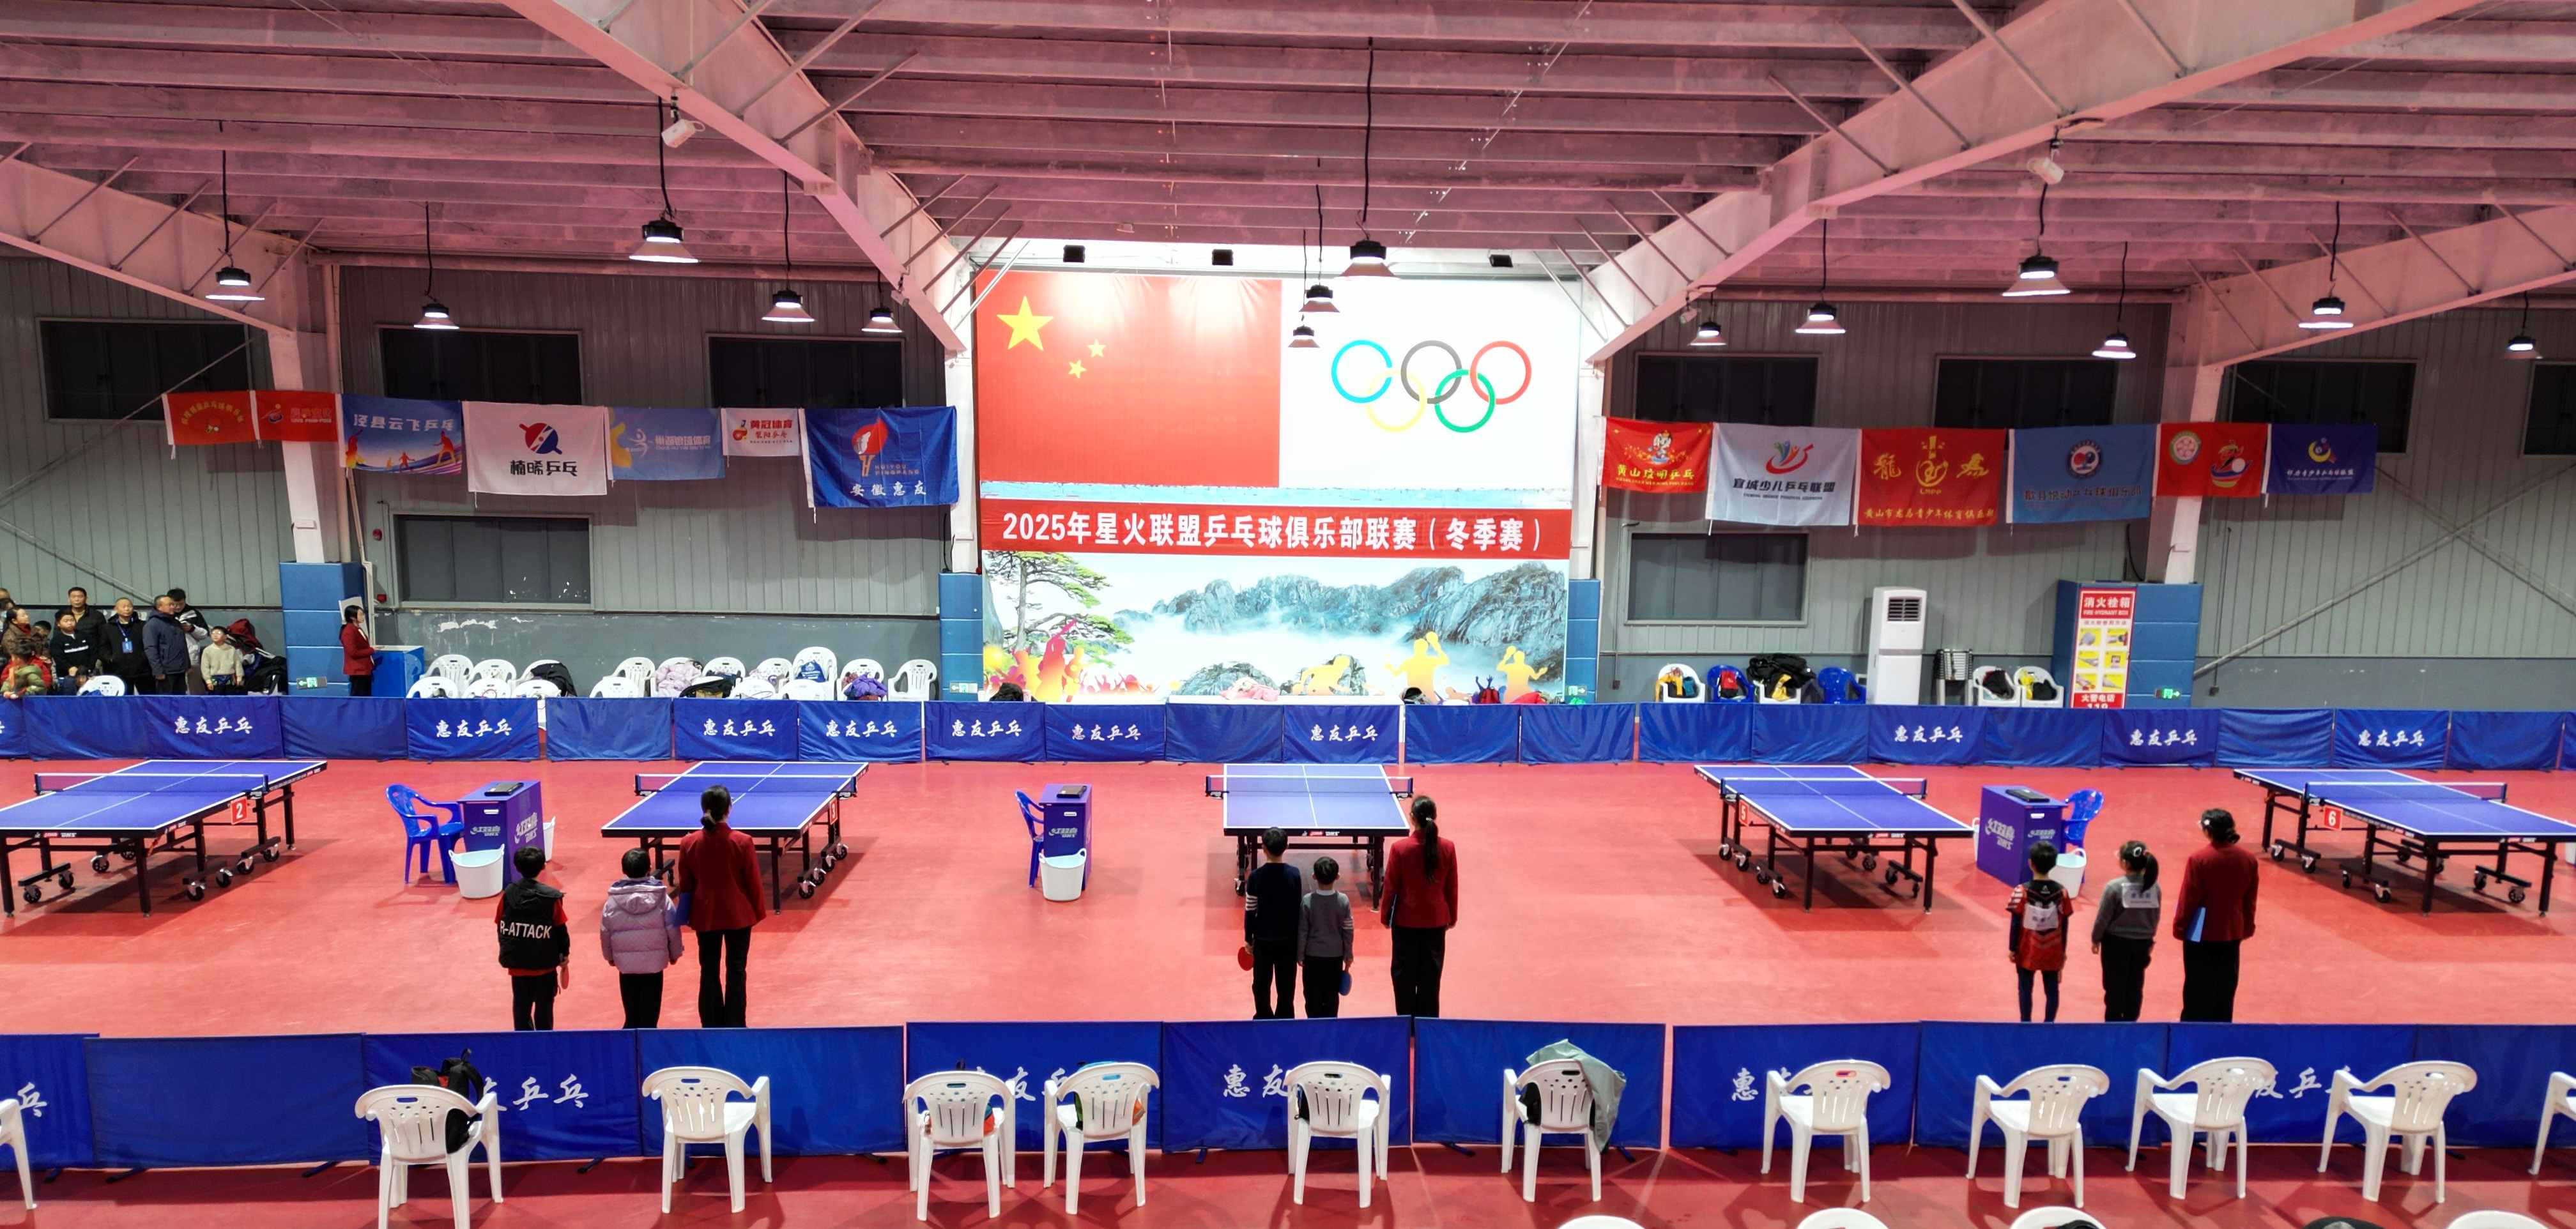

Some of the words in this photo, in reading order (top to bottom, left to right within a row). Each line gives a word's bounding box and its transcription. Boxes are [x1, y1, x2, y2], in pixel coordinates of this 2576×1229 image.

[850, 480, 926, 497] 安徽惠友
[1733, 478, 1836, 492] 宣城少儿乒乓联盟
[2084, 597, 2131, 608] 消火栓箱
[2081, 694, 2115, 703] 火警电话
[174, 716, 252, 734] 惠友乒乓
[436, 719, 511, 737] 惠友乒乓
[704, 719, 775, 736] 惠友乒乓
[826, 720, 897, 737] 惠友乒乓
[952, 719, 1022, 737] 惠友乒乓
[1072, 724, 1140, 741] 惠友乒乓
[1310, 724, 1377, 741] 惠友乒乓
[1895, 726, 1963, 742] 惠友乒乓
[2130, 729, 2197, 746] 惠友乒乓
[2359, 730, 2424, 746] 惠友乒乓
[236, 803, 243, 819] 2
[1741, 805, 1746, 820] 5
[2328, 811, 2336, 826] 6
[500, 920, 552, 938] R-ATTACK
